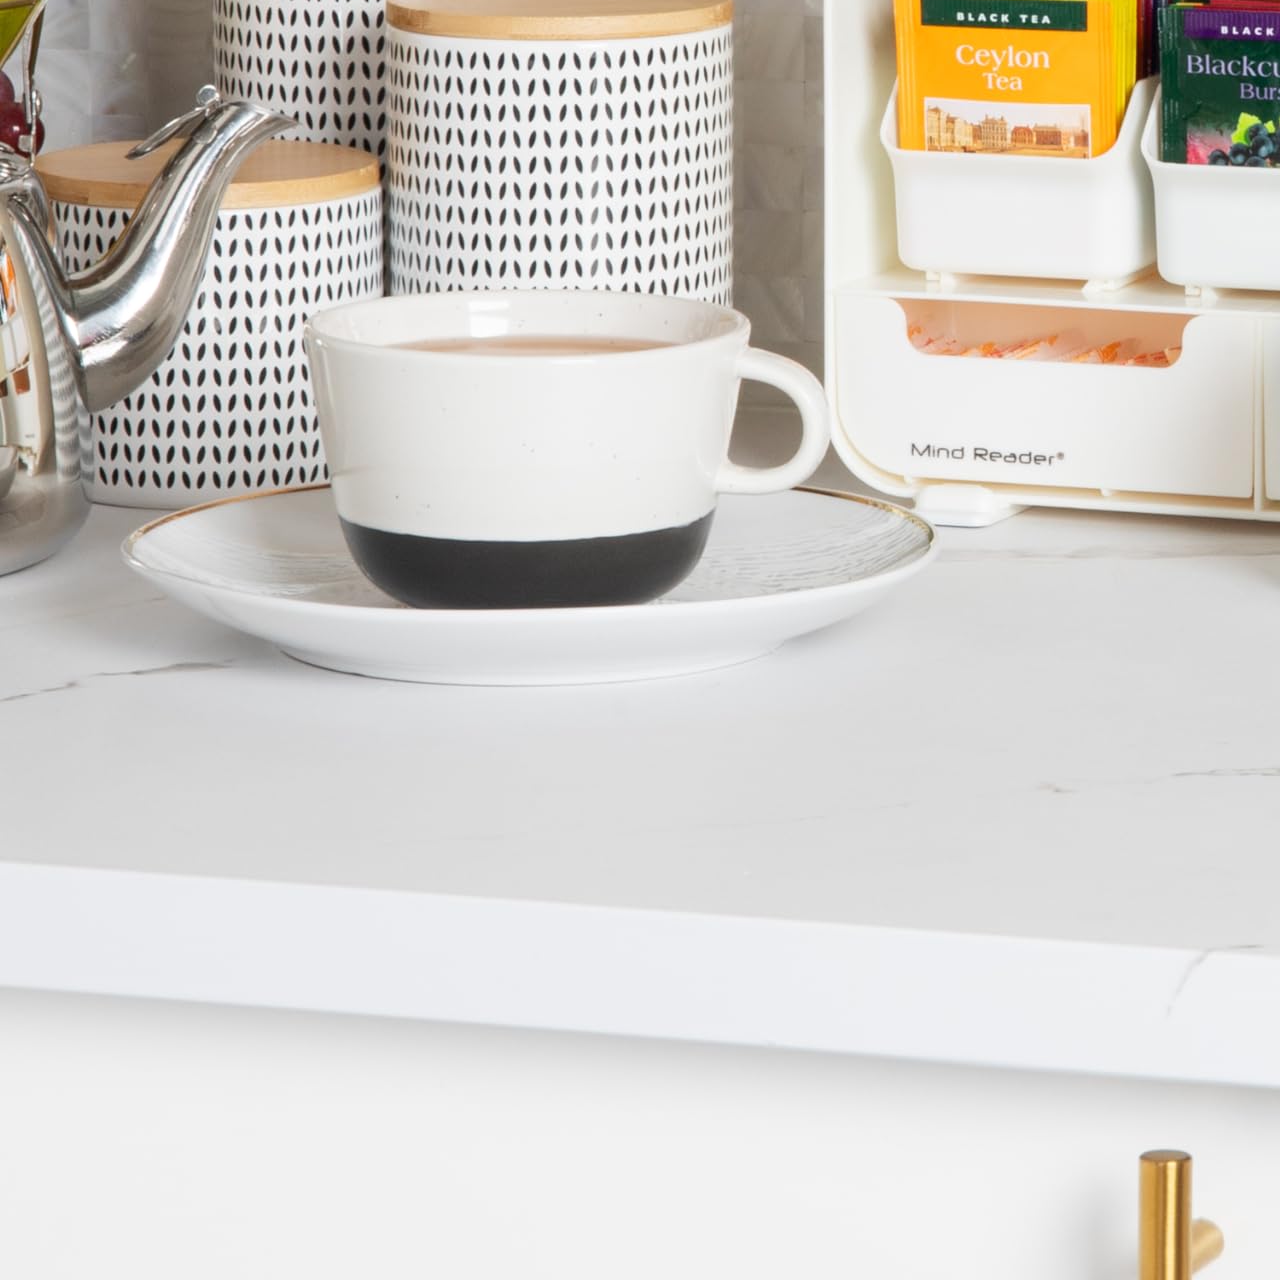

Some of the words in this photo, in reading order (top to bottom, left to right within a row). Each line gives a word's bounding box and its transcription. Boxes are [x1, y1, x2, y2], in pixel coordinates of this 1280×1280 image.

[956, 12, 1010, 24] BLACK
[1020, 14, 1052, 25] TEA
[1220, 26, 1275, 37] BLACK
[955, 44, 1050, 72] Ceylon
[982, 72, 1023, 91] Tea
[911, 443, 965, 460] Mind
